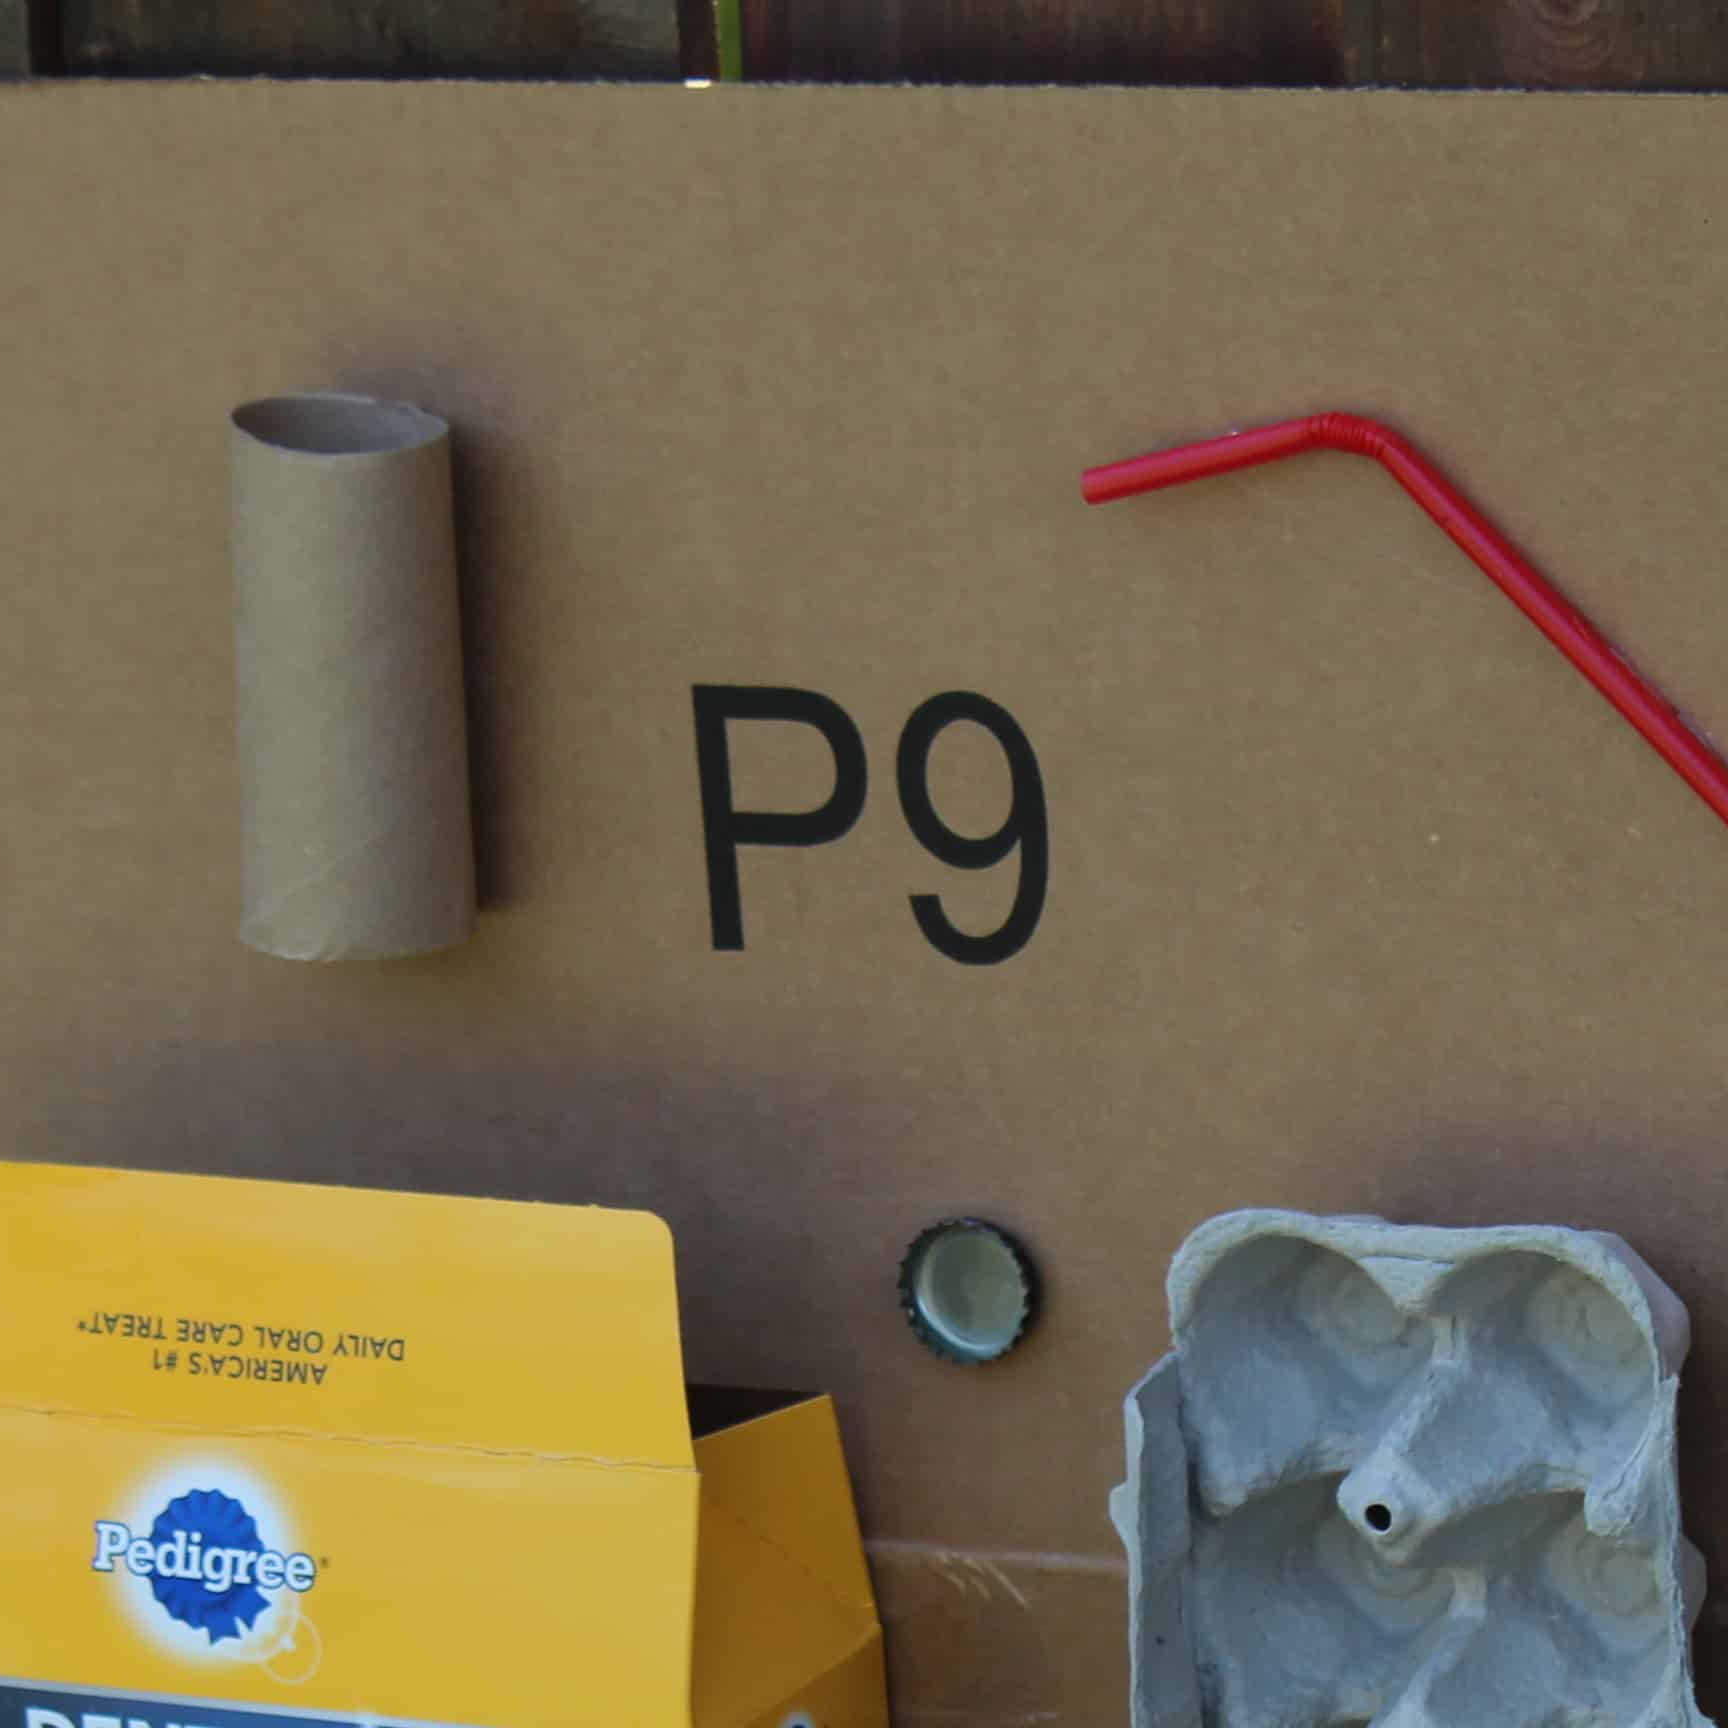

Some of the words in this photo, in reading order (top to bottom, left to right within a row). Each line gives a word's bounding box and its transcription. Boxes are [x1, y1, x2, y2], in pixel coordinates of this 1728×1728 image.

[691, 683, 1049, 967] P9
[176, 1317, 244, 1347] CARE
[255, 1325, 324, 1354] ORAL
[152, 1349, 177, 1371] #1
[332, 1333, 406, 1362] DAILY
[189, 1351, 328, 1385] AMERICA'S
[92, 1520, 317, 1592] Pedigree
